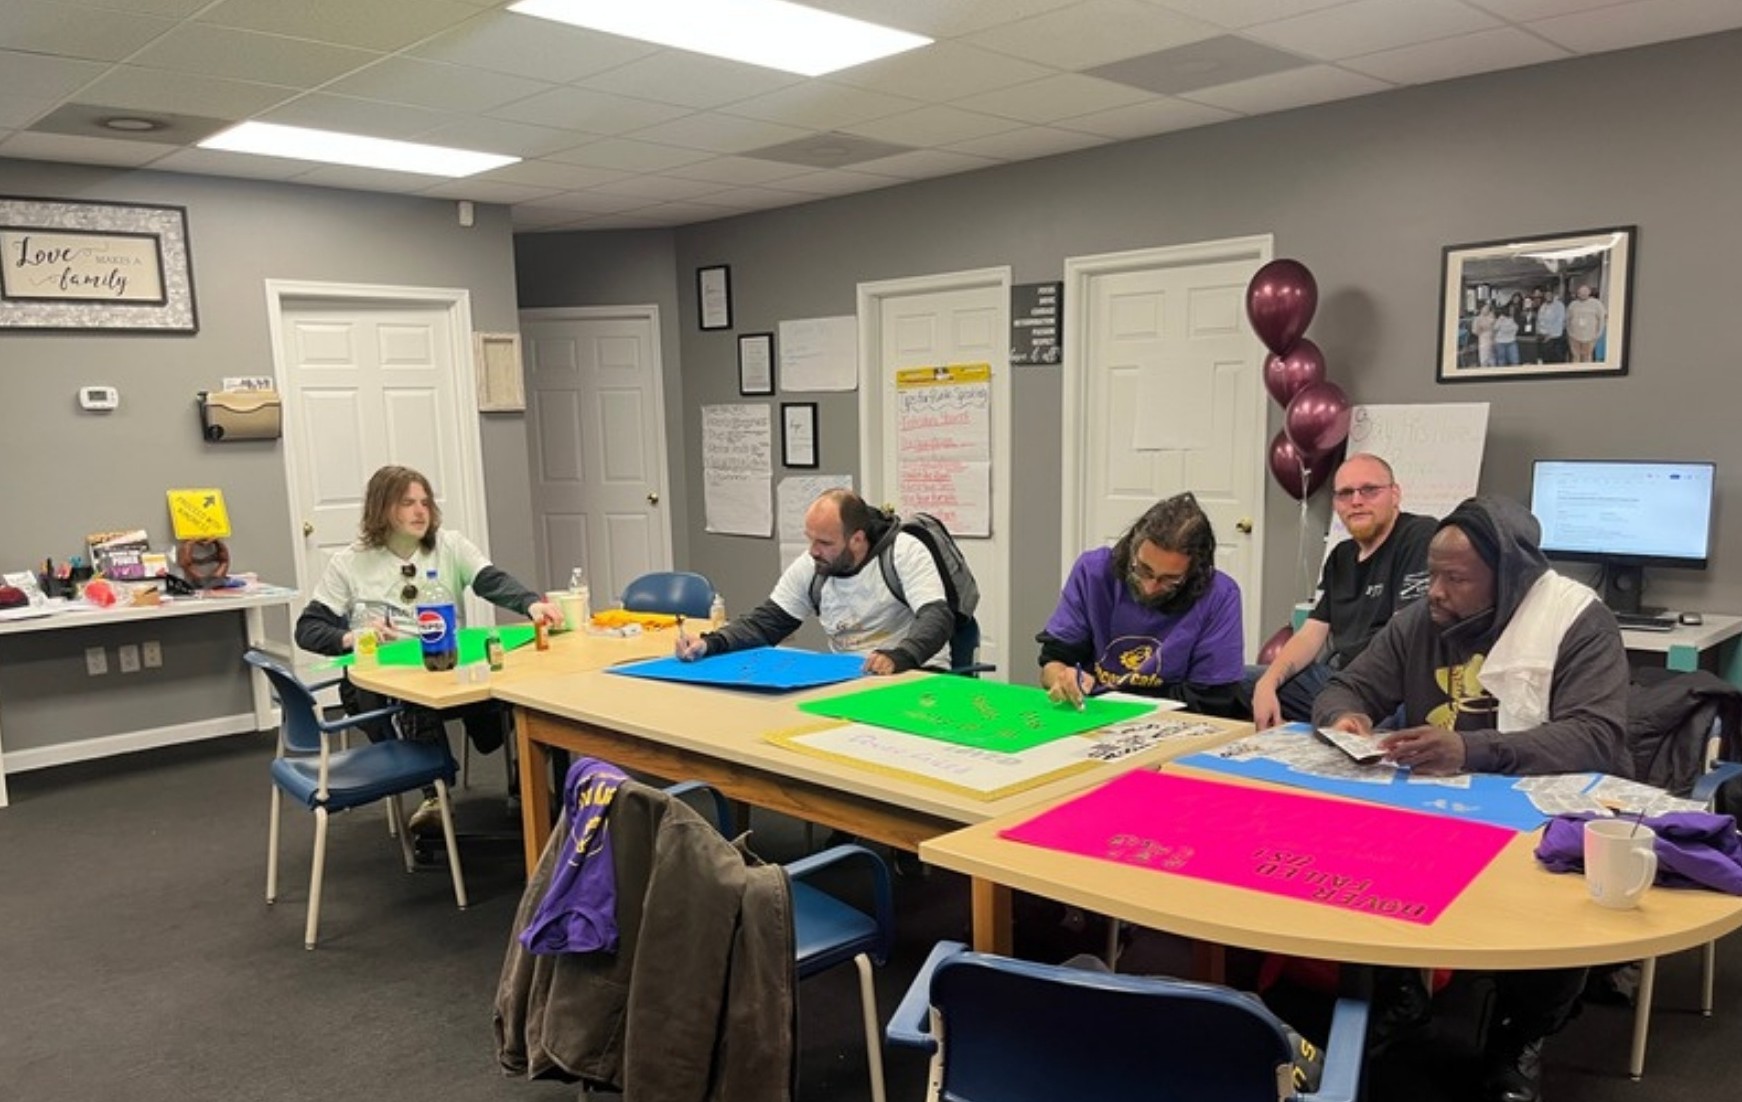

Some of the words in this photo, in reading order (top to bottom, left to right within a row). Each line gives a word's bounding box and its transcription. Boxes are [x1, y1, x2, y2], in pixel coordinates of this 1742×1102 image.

[13, 236, 77, 269] Love
[95, 255, 130, 264] MAKES
[132, 256, 142, 265] A
[59, 266, 127, 296] family
[1255, 863, 1371, 892] FAILED
